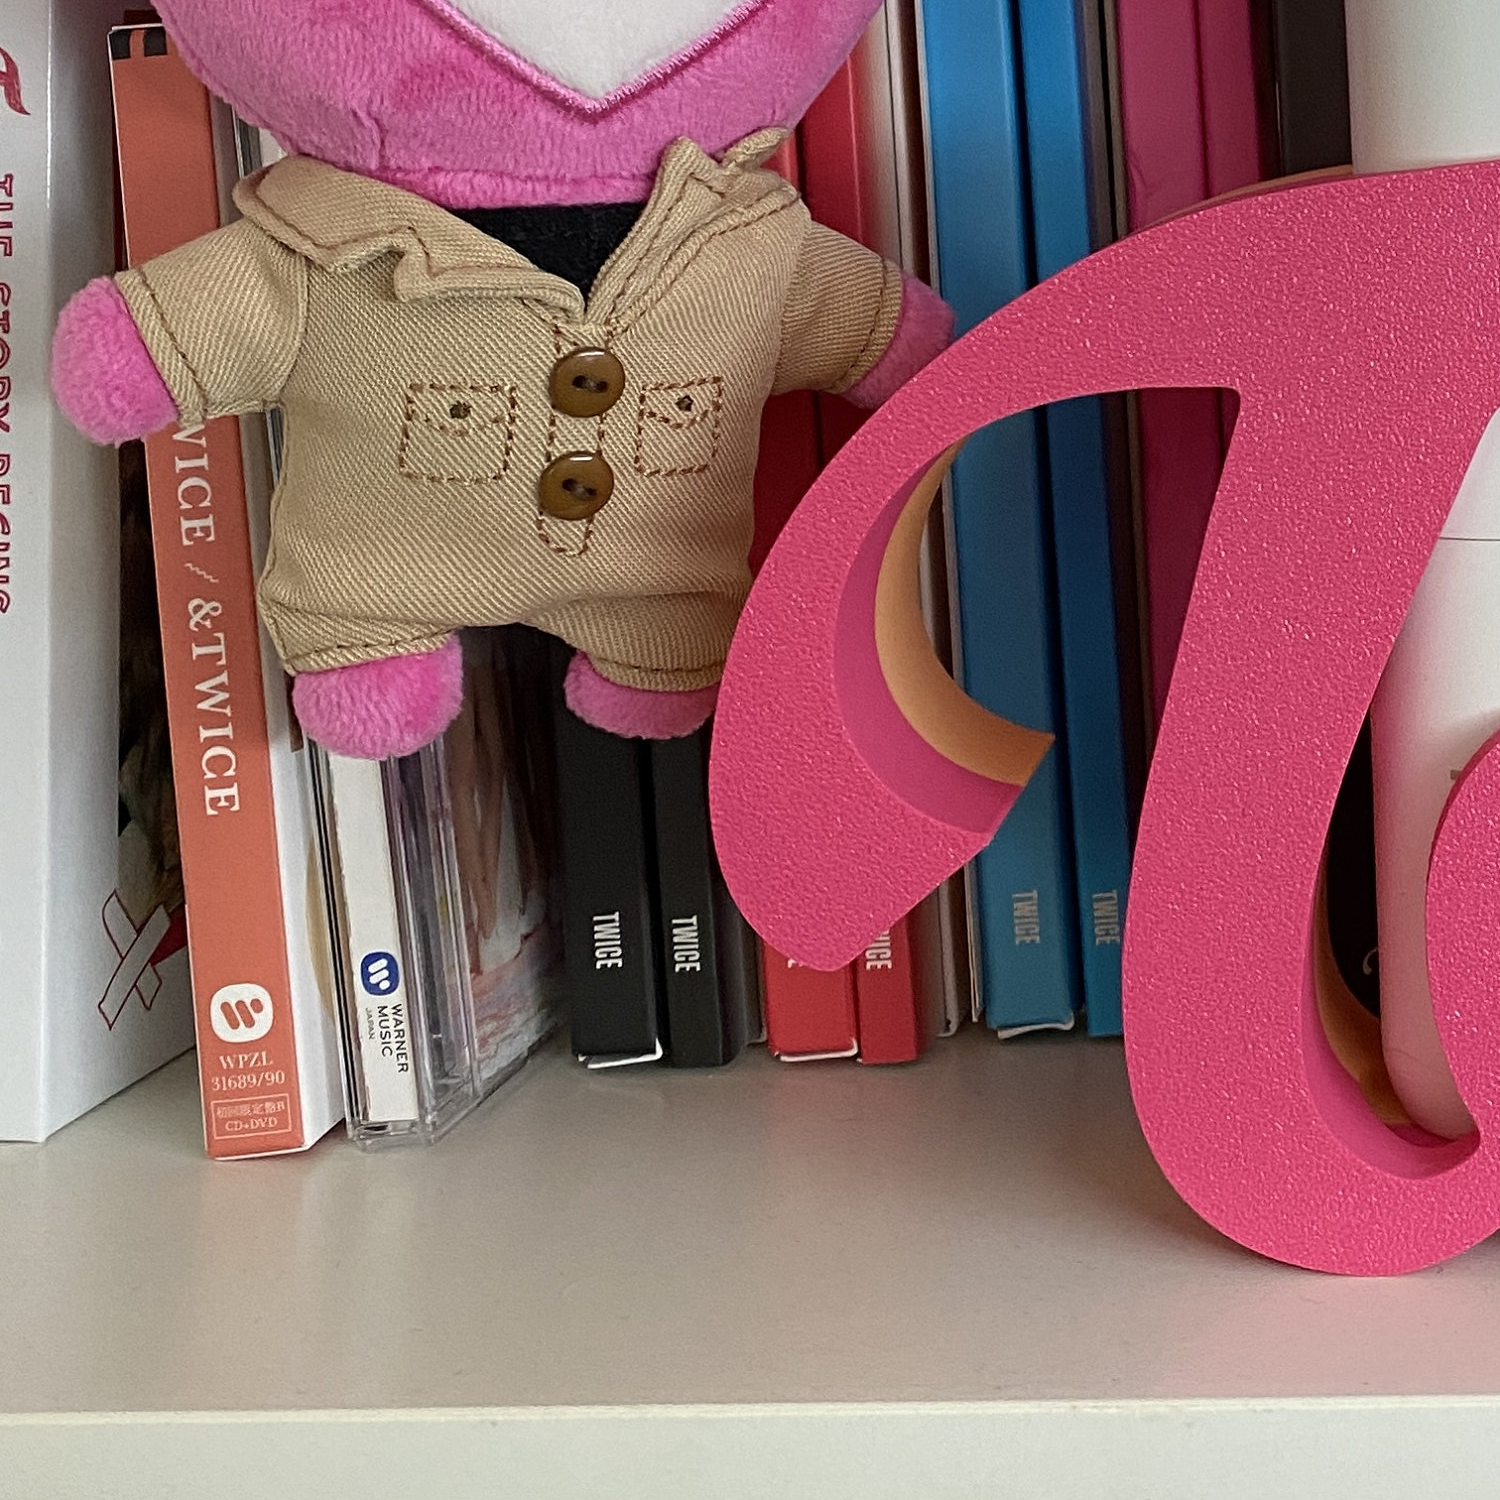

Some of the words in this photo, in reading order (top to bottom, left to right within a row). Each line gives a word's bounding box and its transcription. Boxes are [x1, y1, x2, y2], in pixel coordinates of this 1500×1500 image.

[172, 423, 216, 547] WICE
[187, 597, 240, 816] &TWICE
[593, 911, 623, 970] TWICE
[672, 915, 701, 973] TWICE
[1012, 889, 1040, 945] TWICE
[1092, 889, 1120, 946] TWICE
[864, 927, 892, 970] ICE
[377, 1005, 393, 1057] MUSIC
[391, 1003, 409, 1073] WARNER
[211, 1070, 286, 1092] 31689/90
[219, 1051, 273, 1070] WPZL
[225, 1117, 278, 1132] CD+DVD
